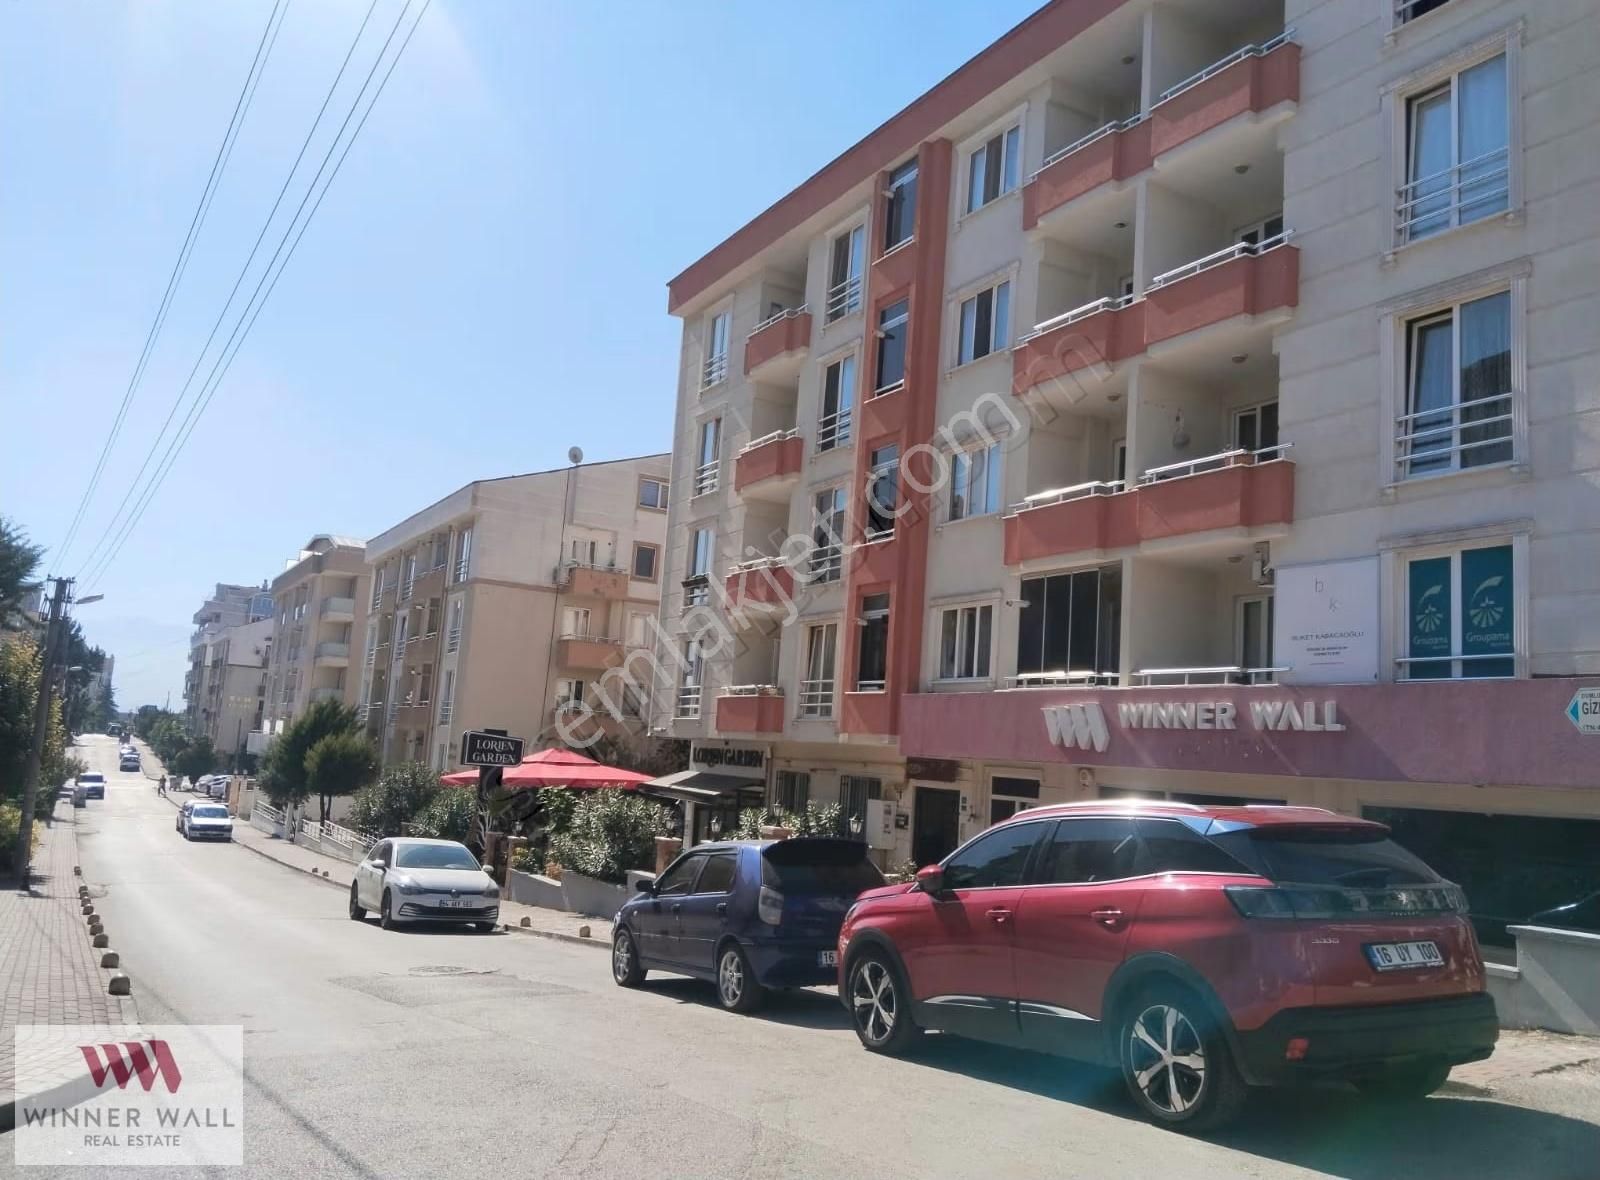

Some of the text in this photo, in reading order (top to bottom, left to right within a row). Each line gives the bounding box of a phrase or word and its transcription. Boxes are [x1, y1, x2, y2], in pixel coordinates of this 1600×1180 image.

[1465, 631, 1510, 644] Groupama
[1581, 698, 1600, 716] GİZ
[1117, 700, 1346, 731] WINNER WALL
[475, 738, 516, 753] LORIEN
[472, 752, 516, 764] GARDEN
[824, 952, 834, 962] 16
[1376, 946, 1393, 964] 16
[1415, 942, 1439, 961] 100
